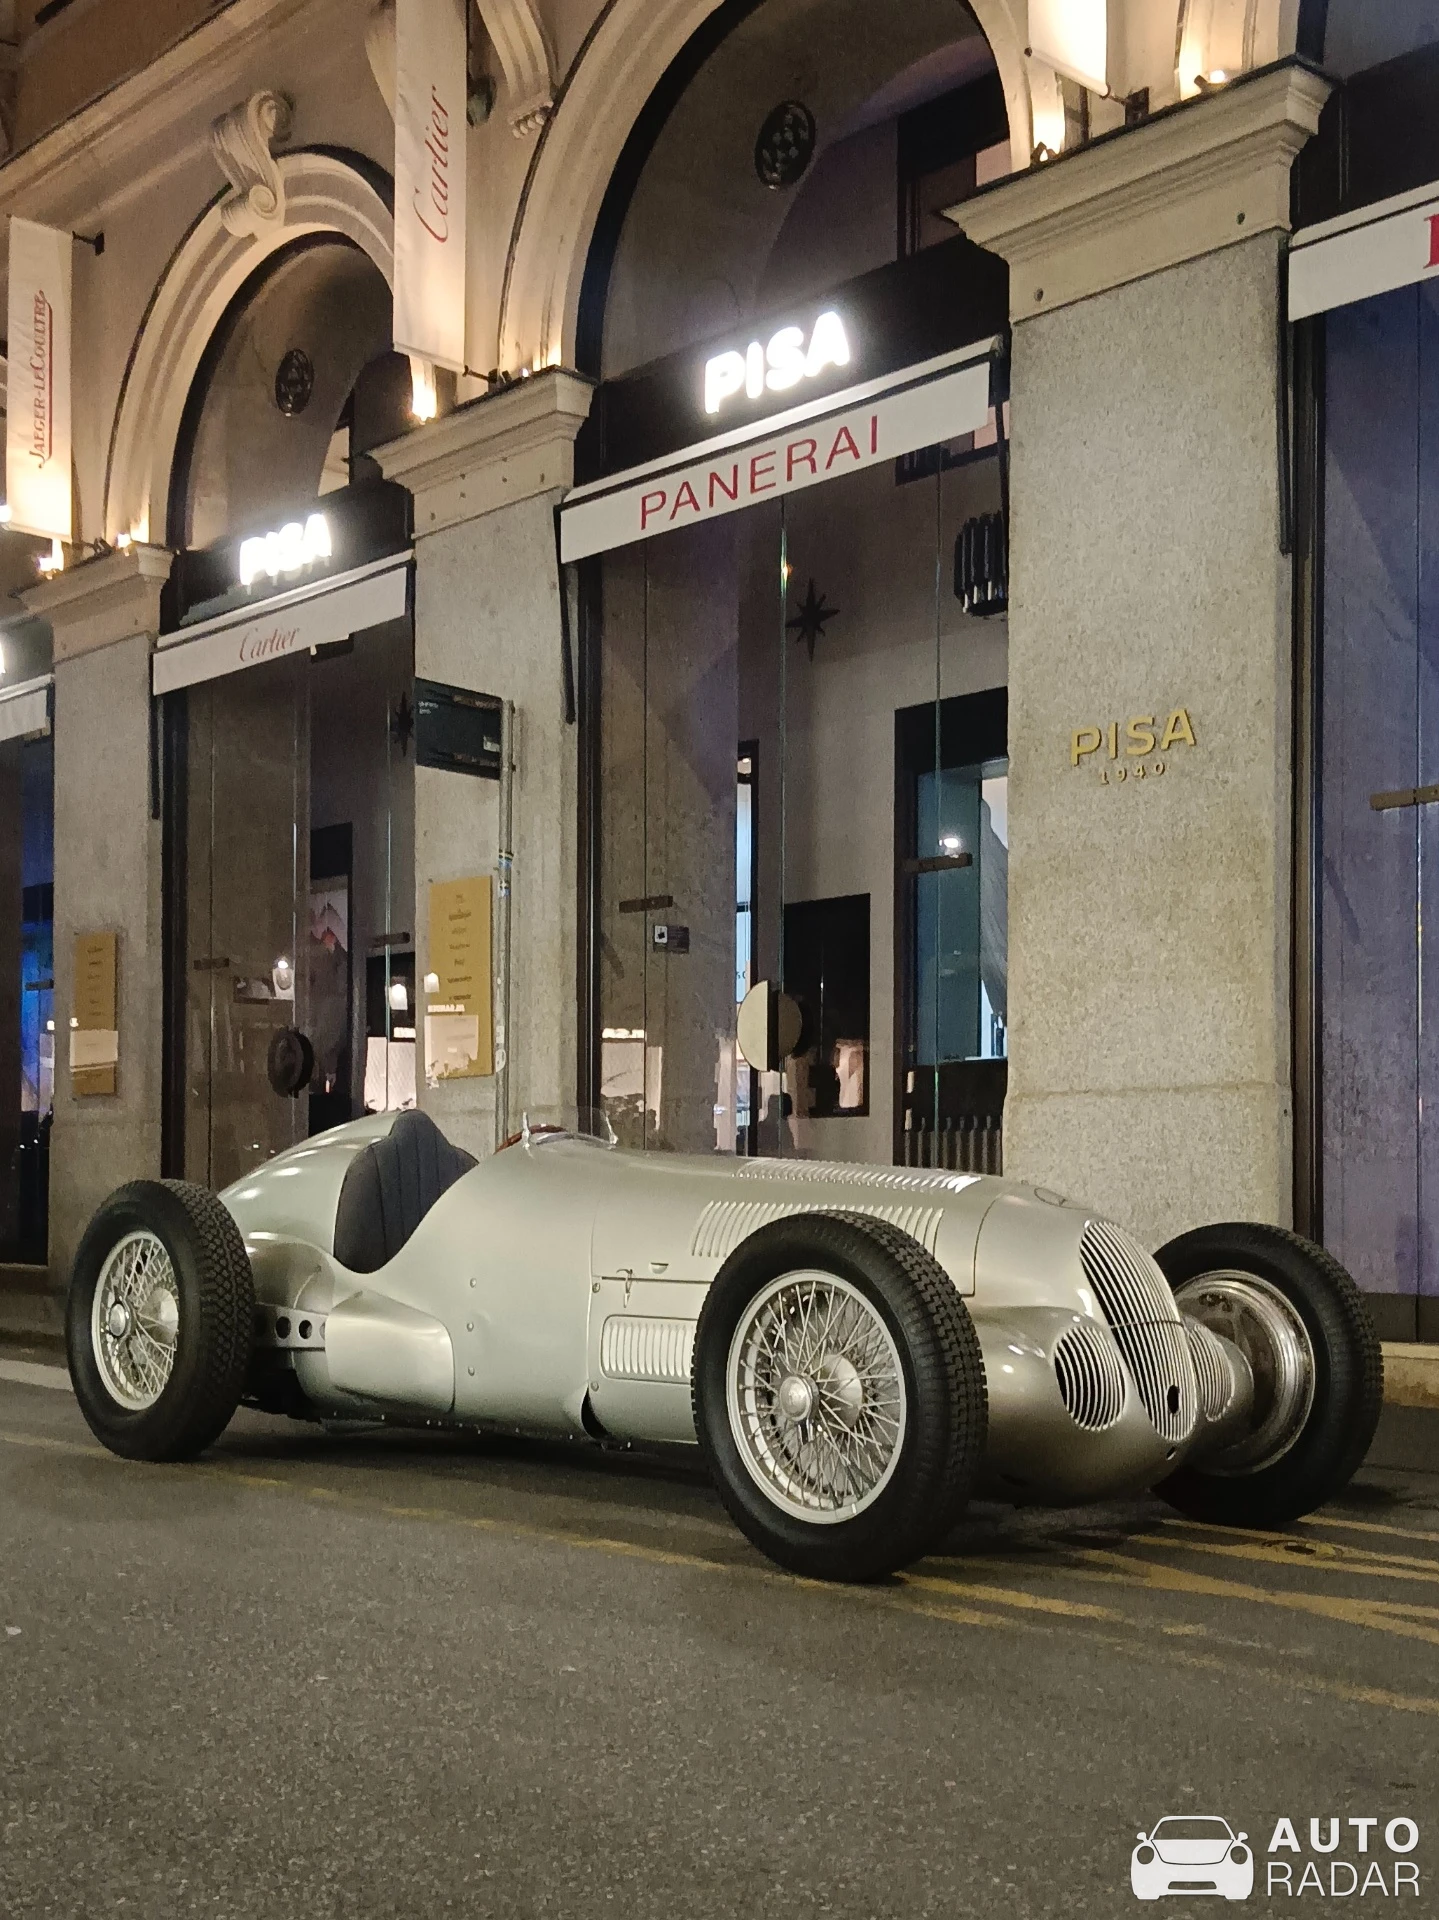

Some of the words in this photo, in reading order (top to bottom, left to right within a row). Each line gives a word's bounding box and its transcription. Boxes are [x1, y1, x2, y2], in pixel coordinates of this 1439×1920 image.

[412, 84, 449, 243] Cartier
[704, 311, 851, 415] PISA
[640, 415, 878, 531] PANERAI
[239, 628, 301, 662] Cartier
[1070, 708, 1197, 767] PISA
[1100, 761, 1166, 785] 1940
